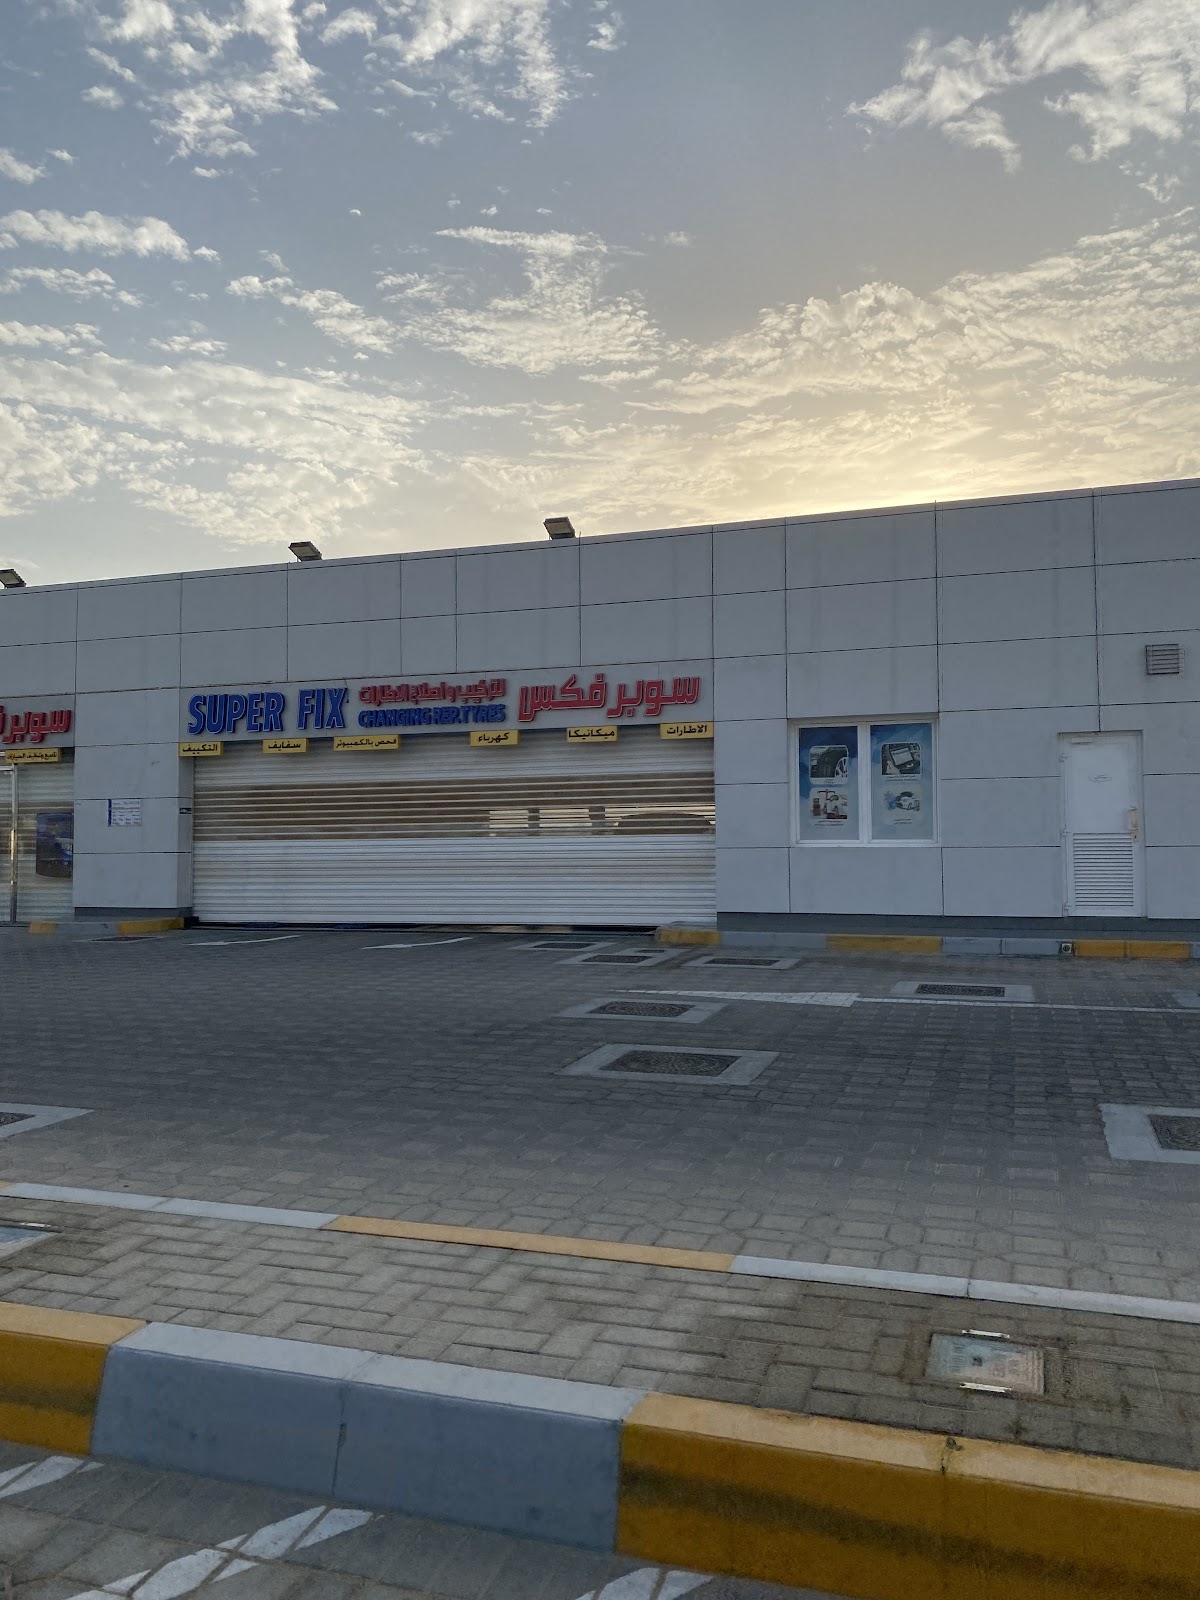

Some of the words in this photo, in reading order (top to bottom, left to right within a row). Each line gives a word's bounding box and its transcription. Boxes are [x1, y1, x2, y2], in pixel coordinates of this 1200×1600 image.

[188, 691, 284, 735] SUPER
[297, 687, 347, 730] FIX
[518, 672, 608, 722] فكس
[606, 676, 701, 719] سوبر
[2, 709, 72, 744] سوبر
[358, 707, 432, 728] CHANGING
[666, 724, 708, 736] الاطارات
[478, 732, 509, 743] كهرباء
